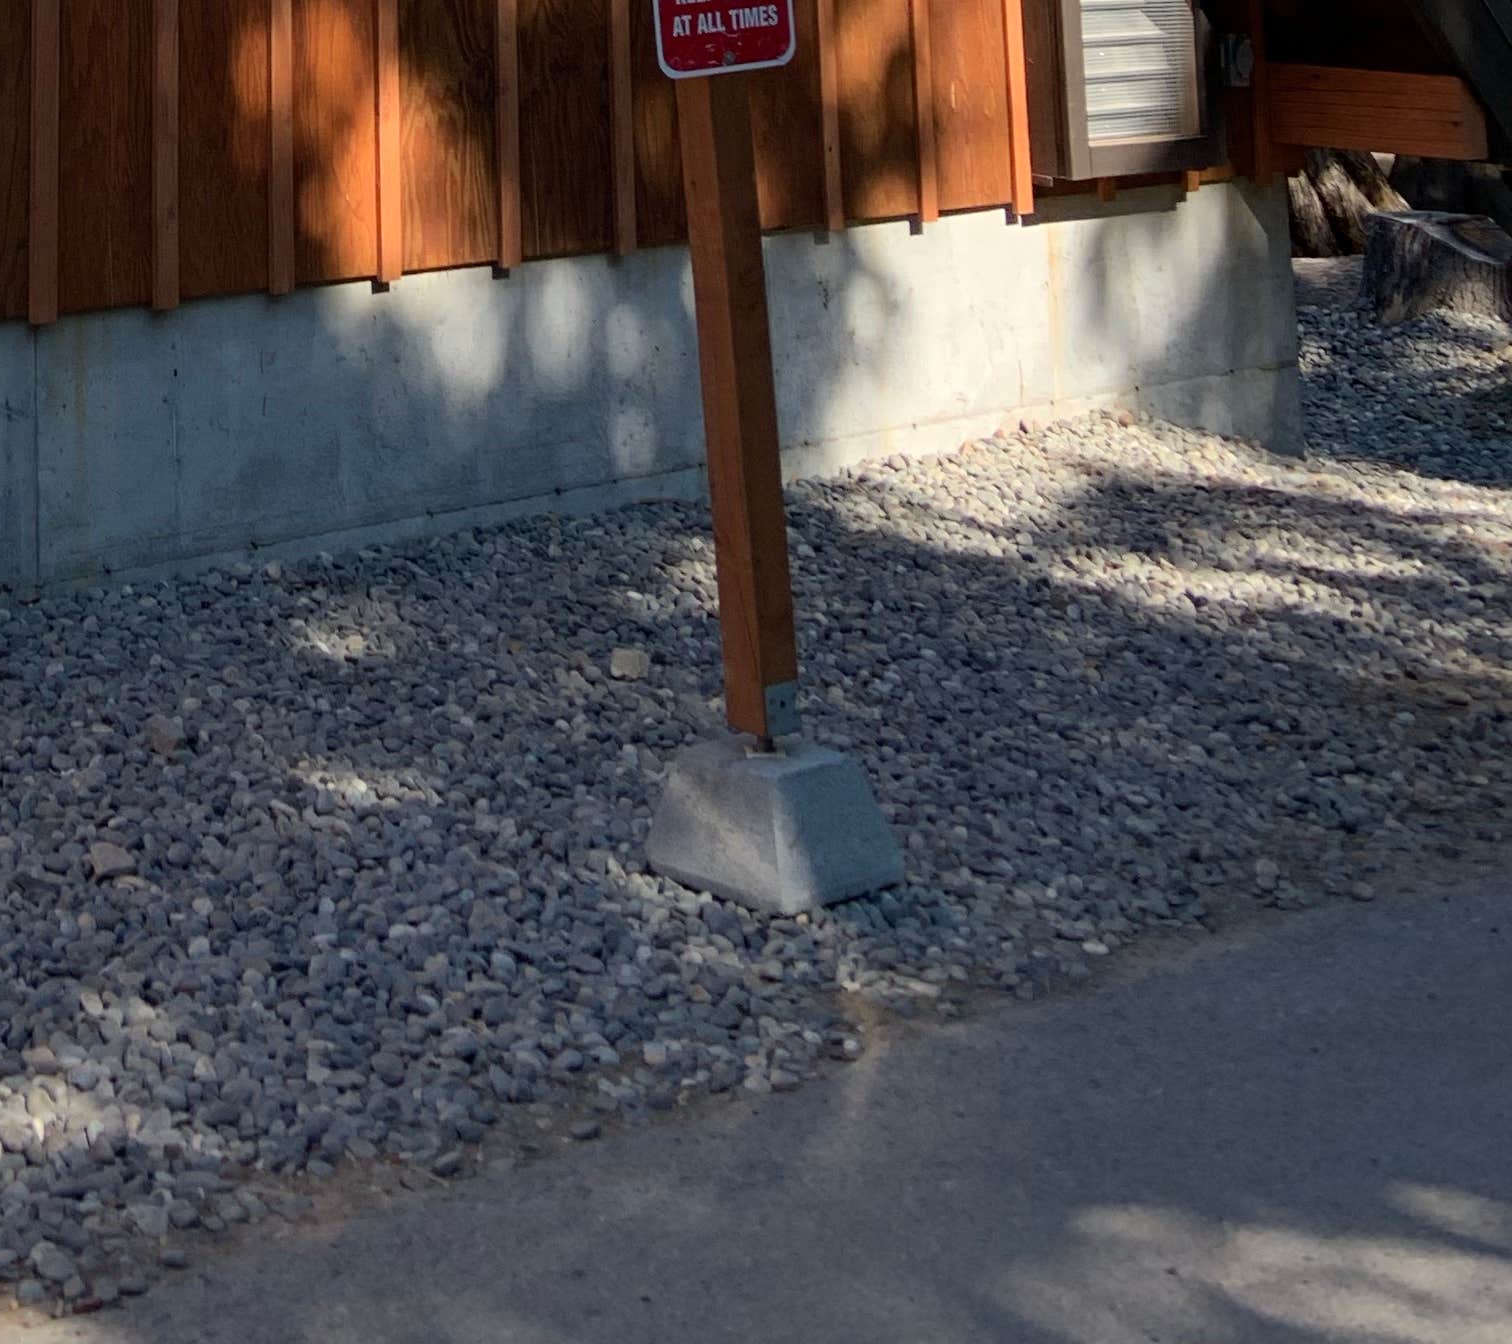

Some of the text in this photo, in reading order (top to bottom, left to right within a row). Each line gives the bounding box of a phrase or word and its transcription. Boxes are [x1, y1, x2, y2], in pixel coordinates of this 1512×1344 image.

[672, 4, 779, 37] AT ALL TIMES
